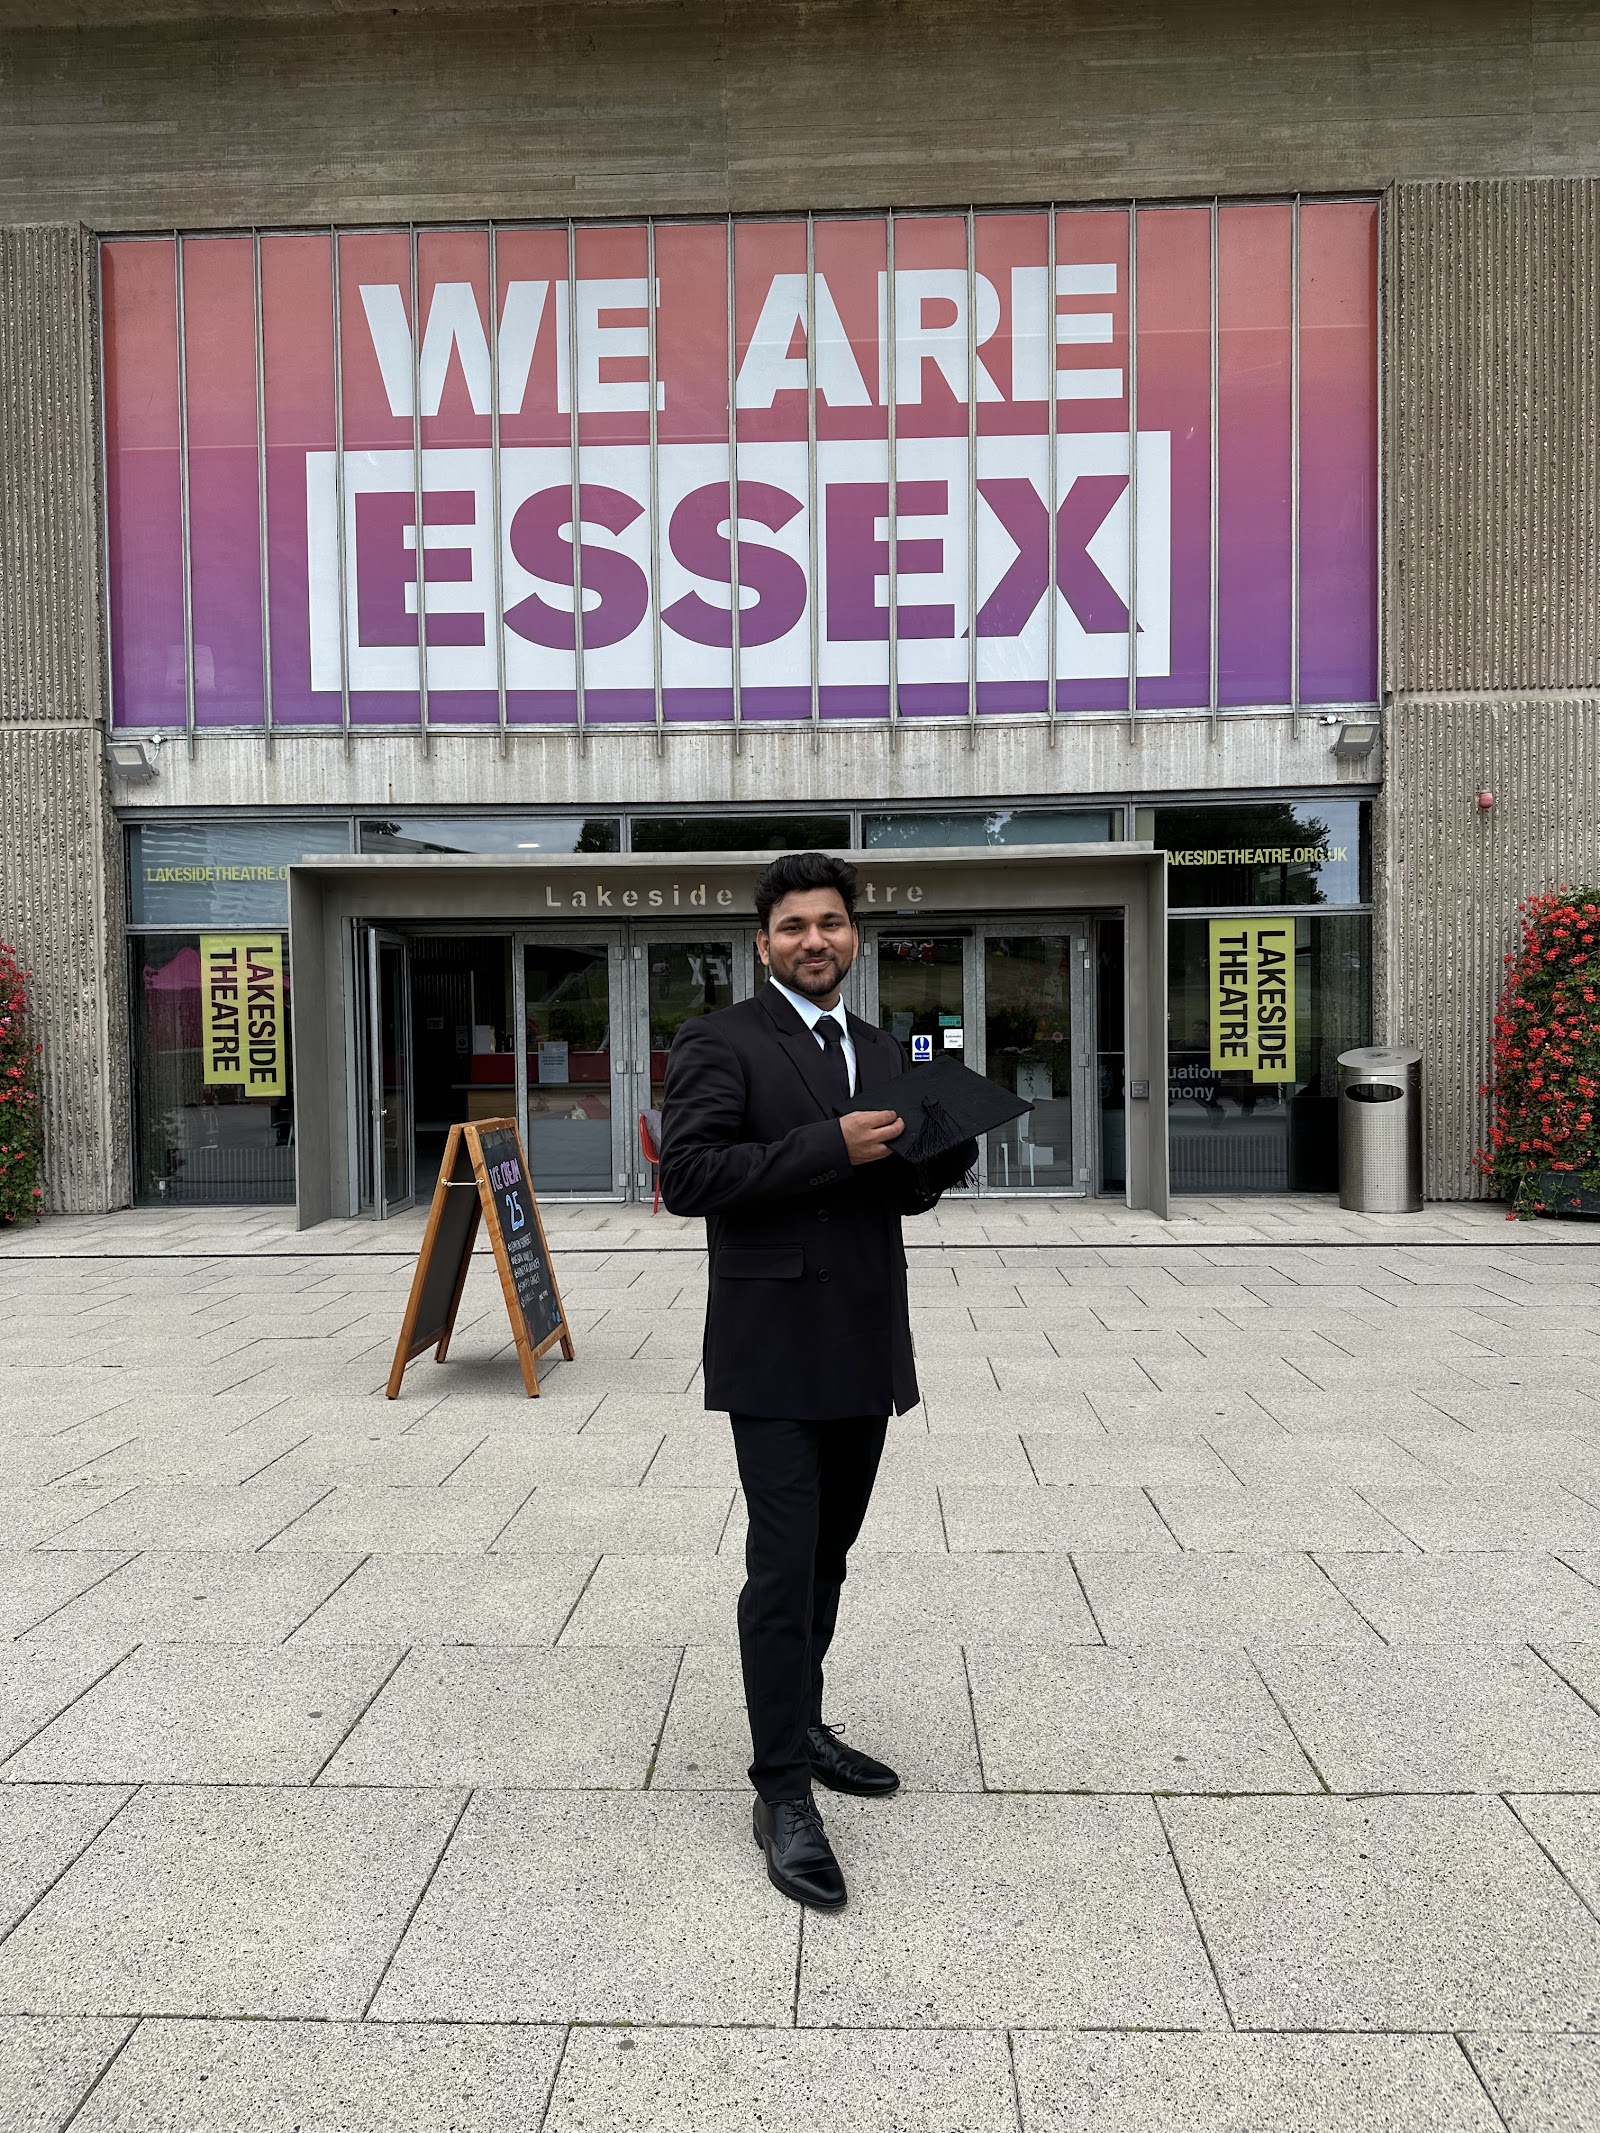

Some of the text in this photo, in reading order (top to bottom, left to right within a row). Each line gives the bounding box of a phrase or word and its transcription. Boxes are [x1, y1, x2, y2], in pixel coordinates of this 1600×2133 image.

[358, 263, 1123, 417] WE ARE
[355, 475, 1144, 651] ESSEX
[147, 866, 287, 882] LAKESIDETHEATRE.O
[545, 882, 923, 907] Lakeside tre
[1167, 847, 1348, 865] AKESIDETHEATRE.ORG.UK
[210, 947, 240, 1072] THEATRE
[246, 947, 277, 1084] LAKESIDE
[1219, 931, 1248, 1058] THEATRE
[1257, 930, 1286, 1070] LAKESIDE
[1168, 1064, 1222, 1079] uation
[1168, 1086, 1214, 1101] mony
[489, 1158, 521, 1192] ICE CREAM
